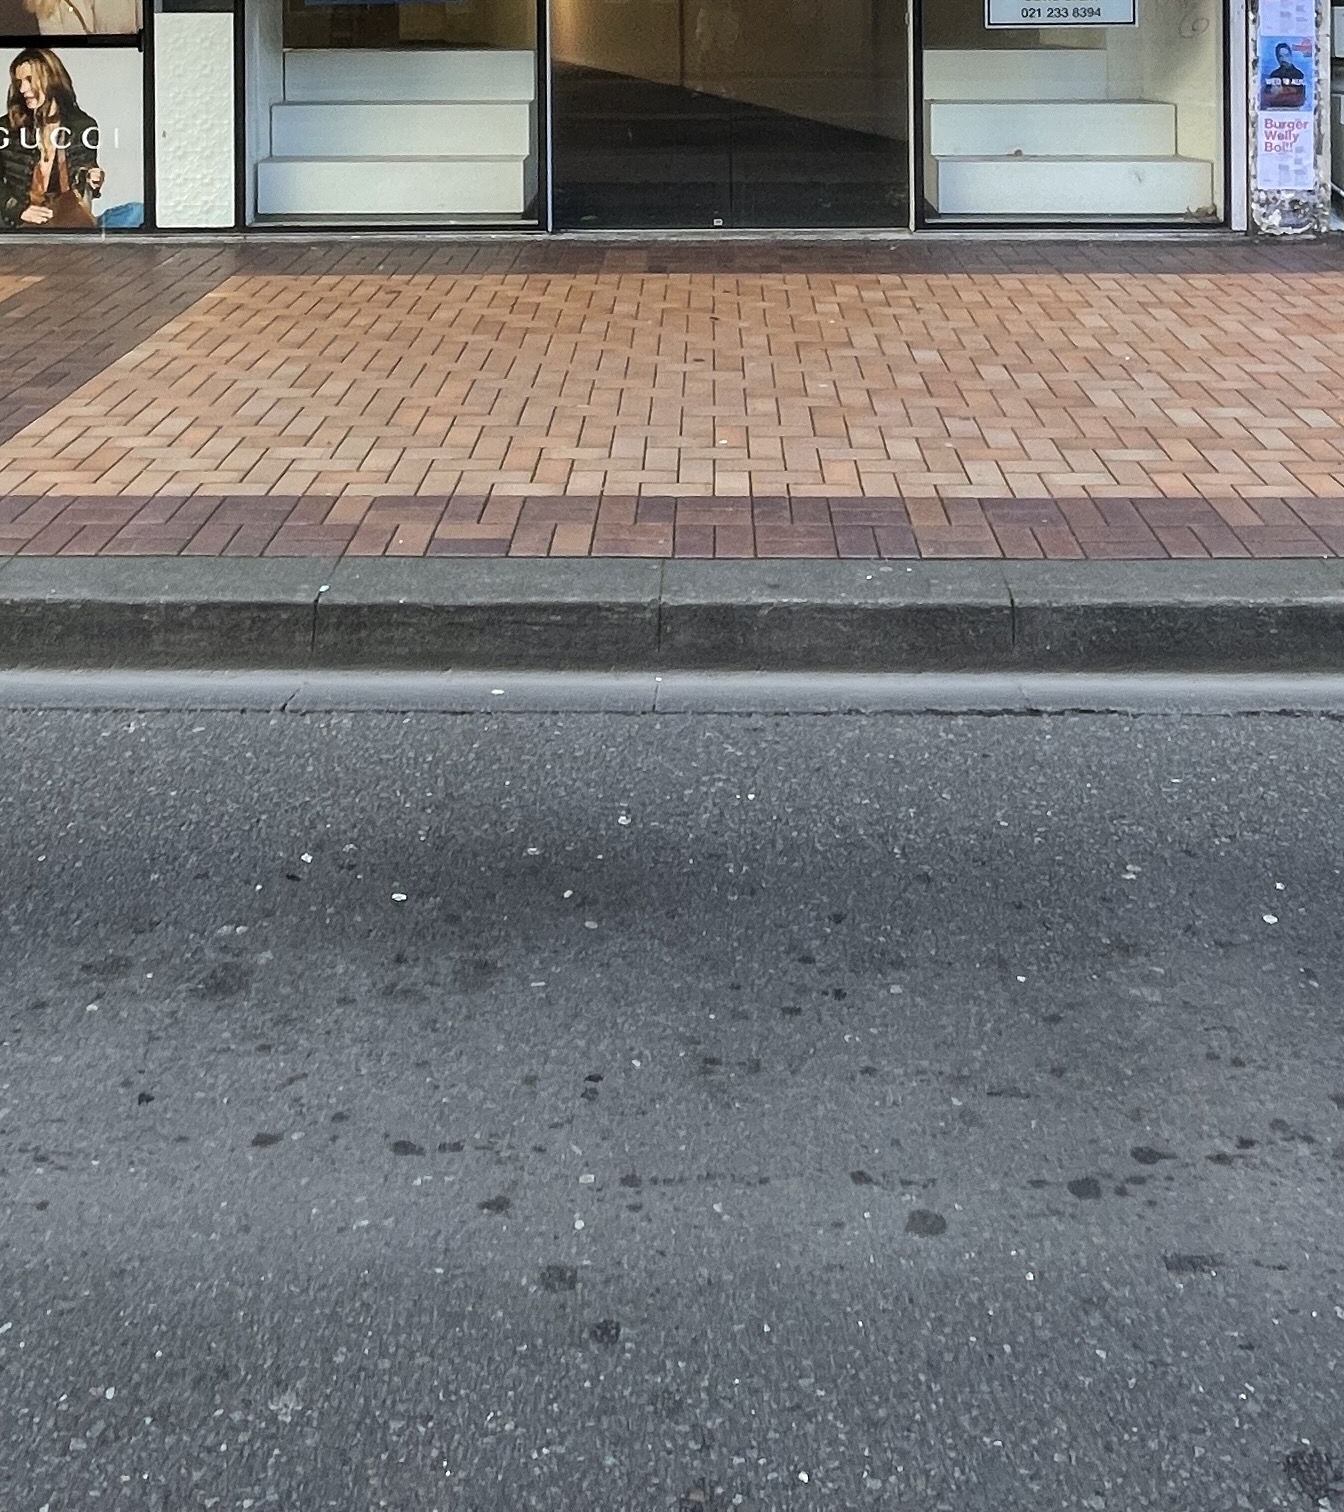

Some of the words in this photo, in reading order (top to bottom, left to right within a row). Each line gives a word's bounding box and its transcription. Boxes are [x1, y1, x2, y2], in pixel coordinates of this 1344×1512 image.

[1021, 7, 1042, 18] 021
[1046, 7, 1069, 18] 233
[1072, 7, 1101, 18] 8394
[1264, 129, 1300, 143] Welly
